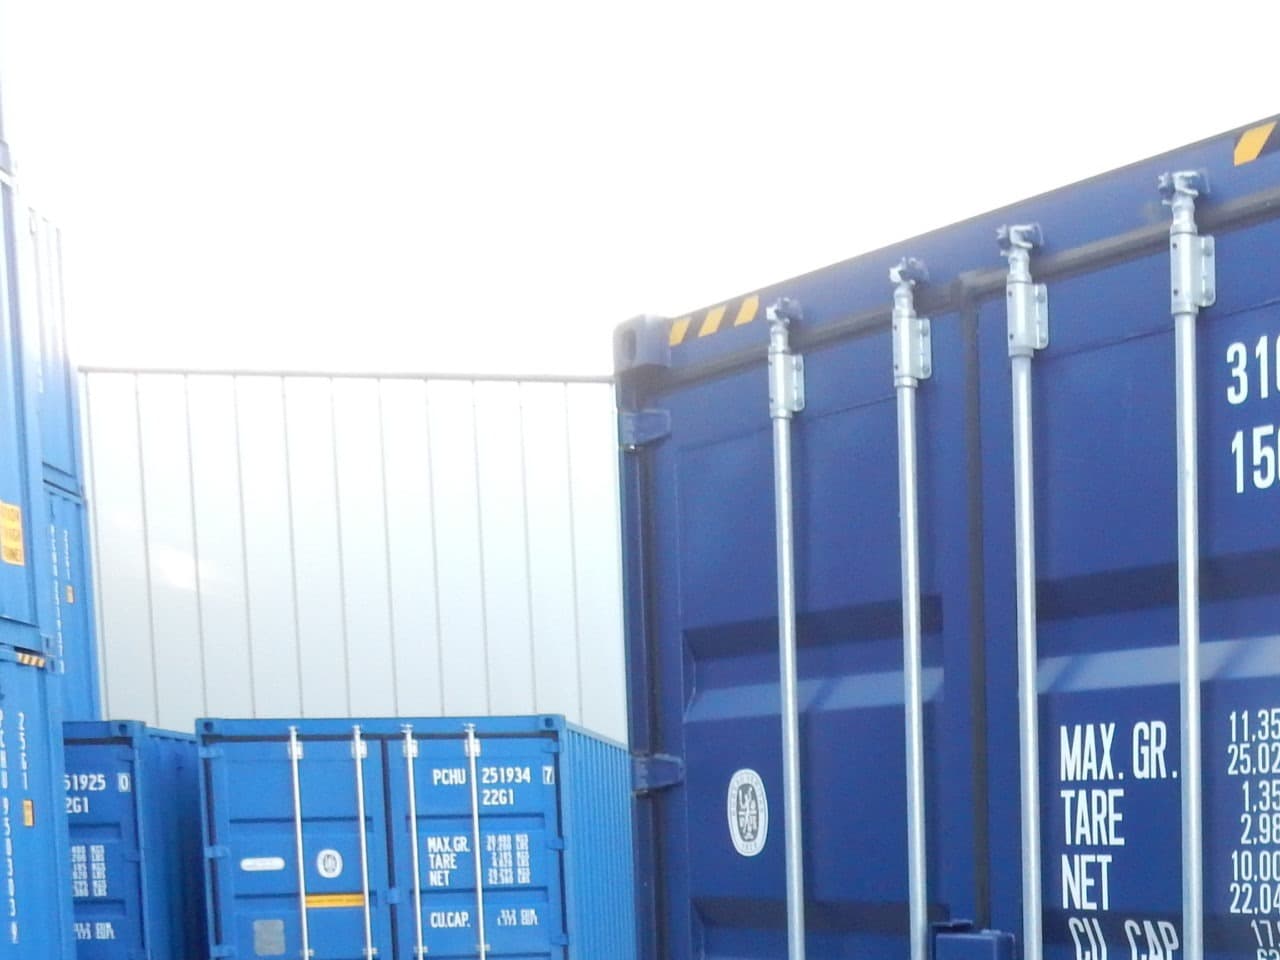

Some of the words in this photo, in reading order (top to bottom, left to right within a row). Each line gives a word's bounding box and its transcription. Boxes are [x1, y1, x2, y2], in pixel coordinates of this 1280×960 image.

[1060, 722, 1124, 781] MAX.
[1133, 720, 1178, 779] GR.
[432, 768, 466, 785] PCHU
[481, 766, 531, 784] 251934
[482, 788, 514, 805] 22G1
[1060, 788, 1125, 846] TARE
[429, 853, 457, 870] TARE
[430, 870, 450, 886] NET
[1061, 853, 1113, 911] NET
